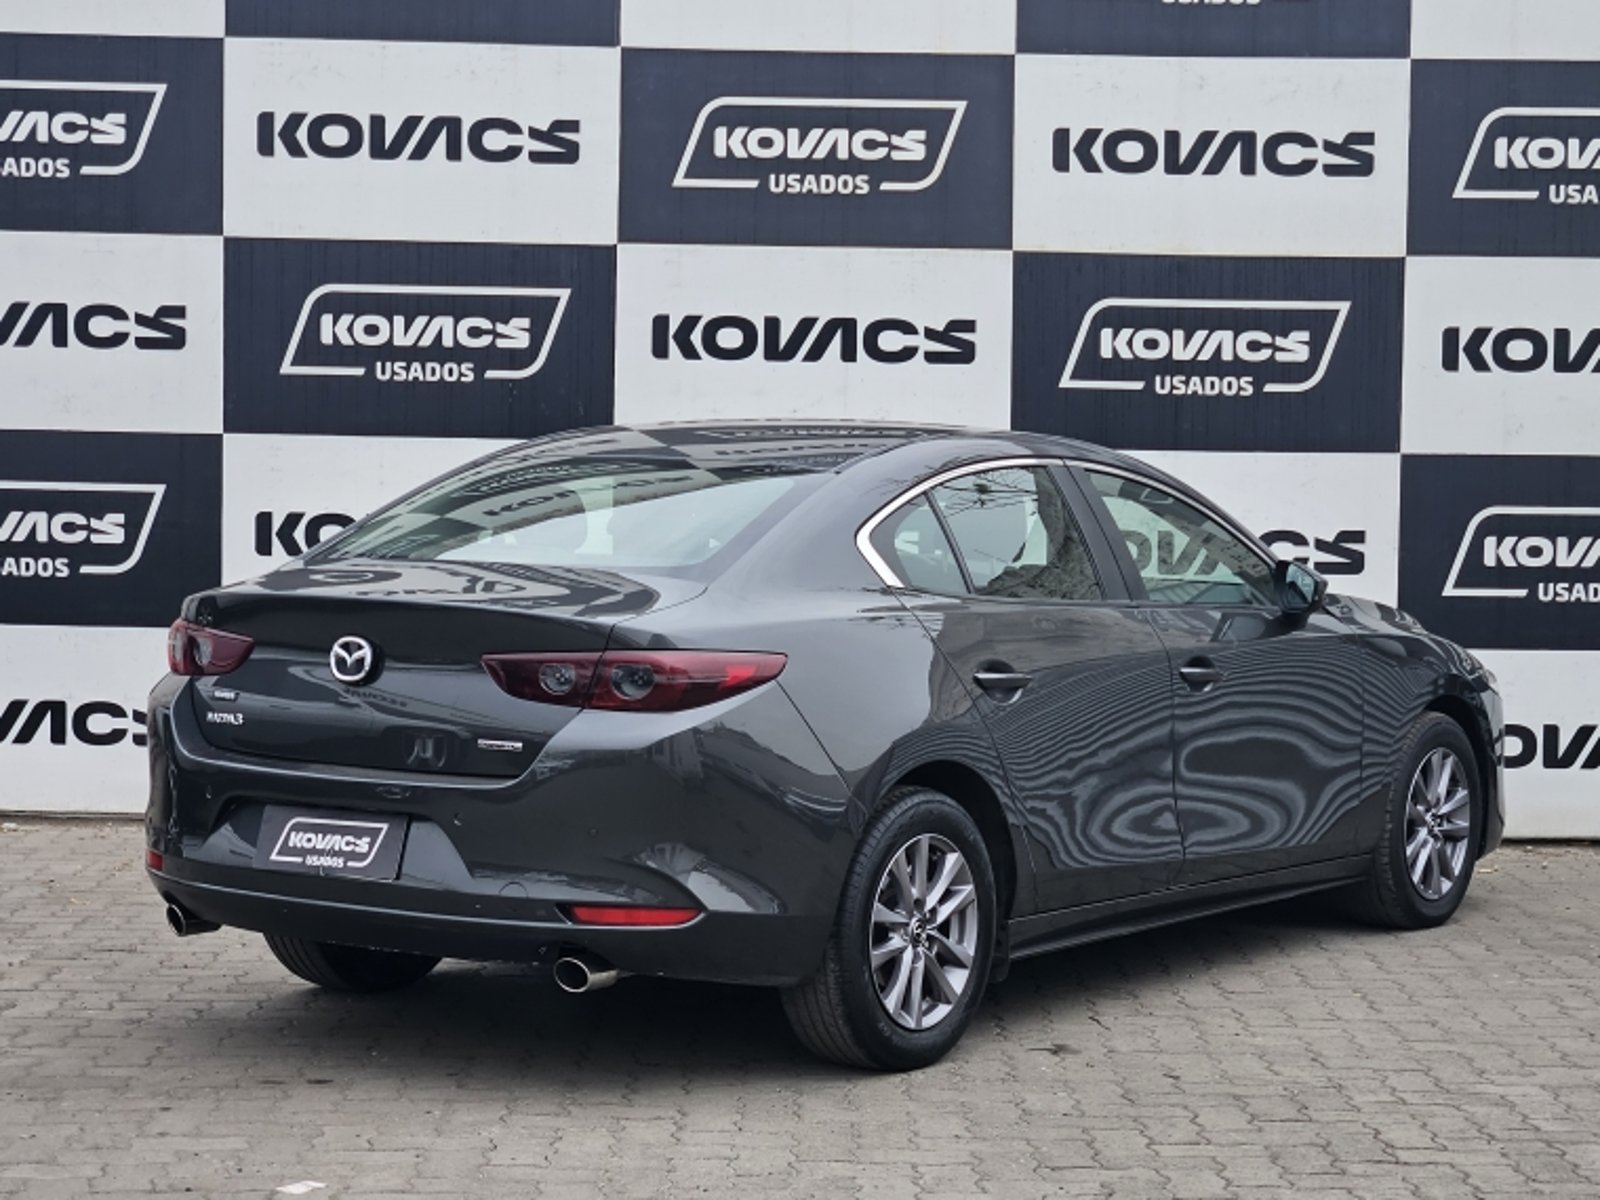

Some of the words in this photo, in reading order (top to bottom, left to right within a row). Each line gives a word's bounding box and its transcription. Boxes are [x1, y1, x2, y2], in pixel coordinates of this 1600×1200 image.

[256, 111, 580, 165] KOVACS
[714, 126, 927, 161] KOVACS
[1052, 127, 1376, 178] KOVACS
[1494, 136, 1600, 169] KOV
[0, 157, 70, 178] ADOS
[769, 173, 870, 195] USADOS
[320, 313, 531, 349] KOVACS
[651, 314, 977, 365] KOVACS
[1100, 327, 1310, 363] KOVACS
[1441, 326, 1600, 373] KOV
[375, 361, 475, 382] USADOS
[1155, 375, 1254, 397] USADOS
[288, 831, 371, 853] KOVACS
[305, 854, 345, 868] USADOS
